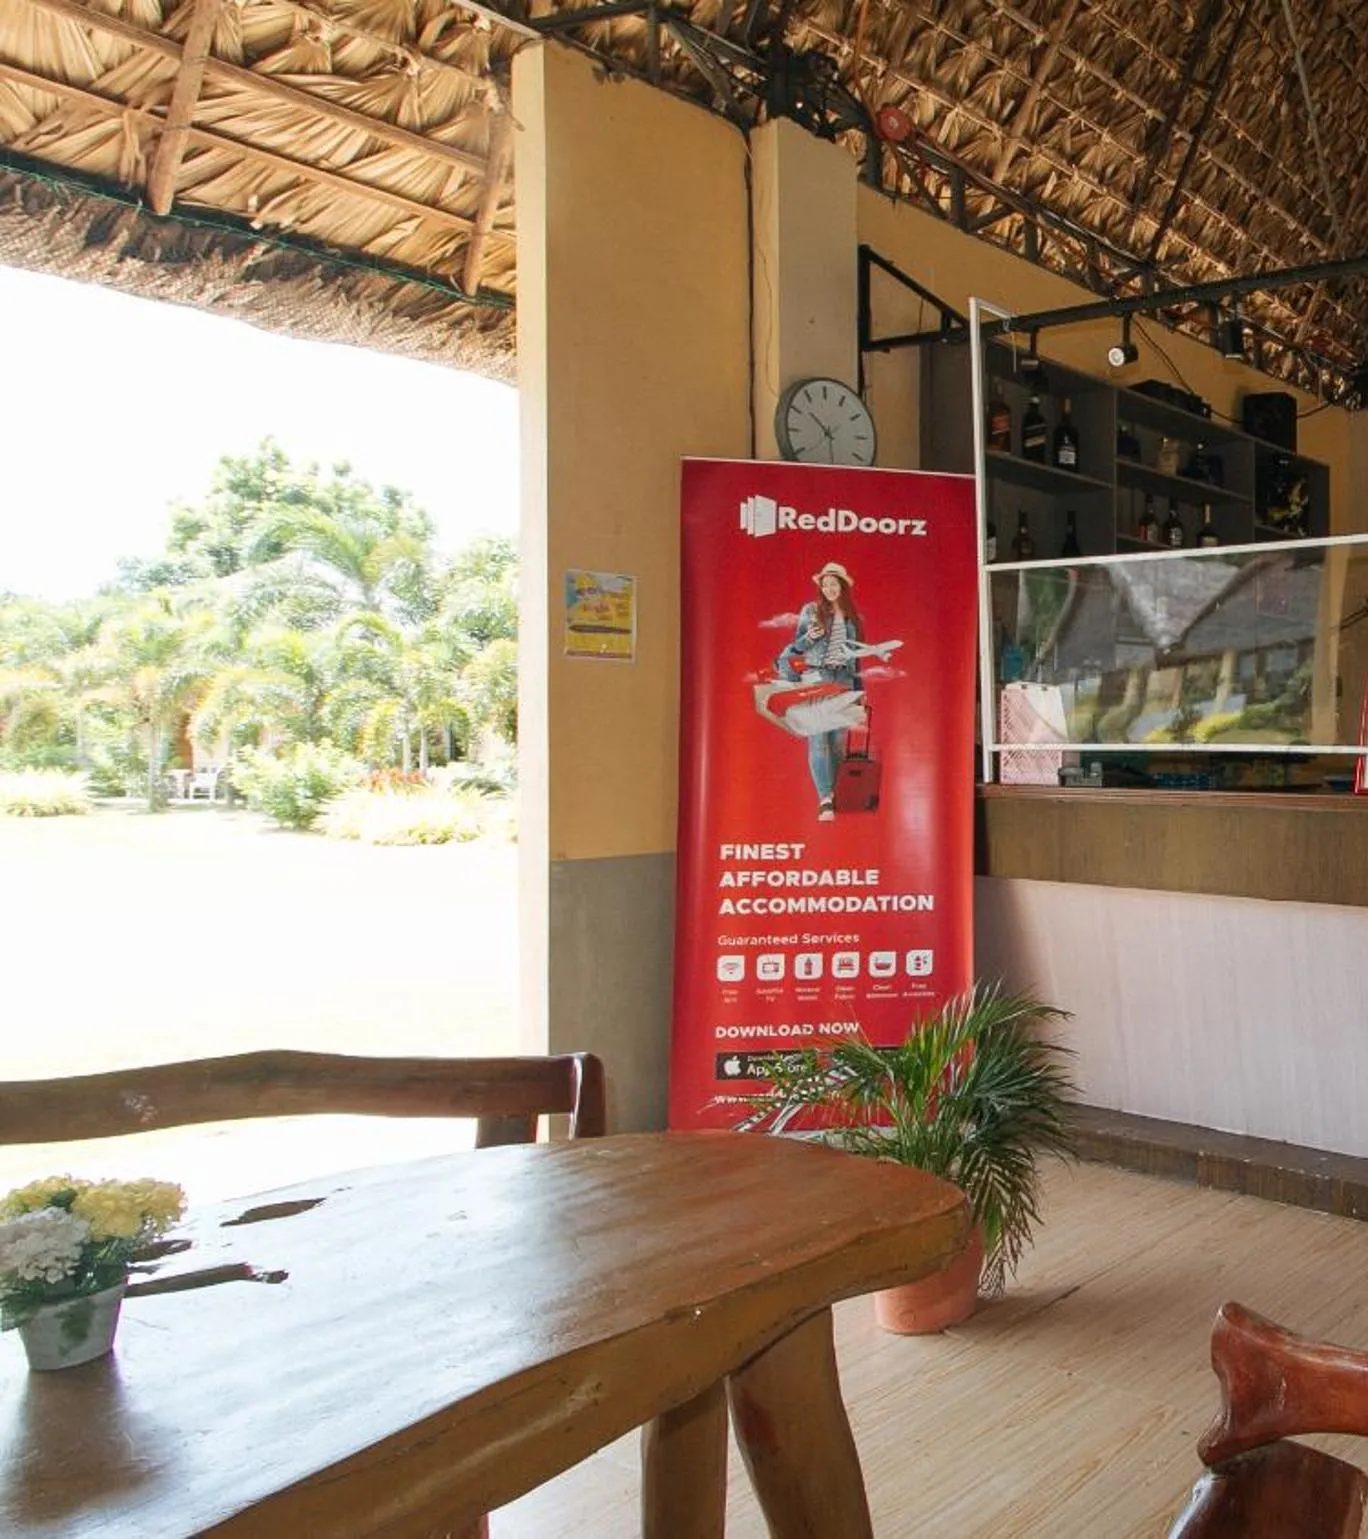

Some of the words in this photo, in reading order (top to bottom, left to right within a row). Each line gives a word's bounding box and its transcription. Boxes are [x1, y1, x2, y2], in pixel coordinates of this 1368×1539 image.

[778, 506, 927, 536] RedDoorz
[720, 843, 805, 861] FINEST
[719, 869, 879, 888] AFFORDABLE
[718, 894, 934, 915] ACCOMMODATION
[717, 934, 798, 946] Guaranteed
[801, 932, 860, 944] Services
[715, 1024, 814, 1039] DOWNLOAD
[818, 1022, 860, 1035] NOW
